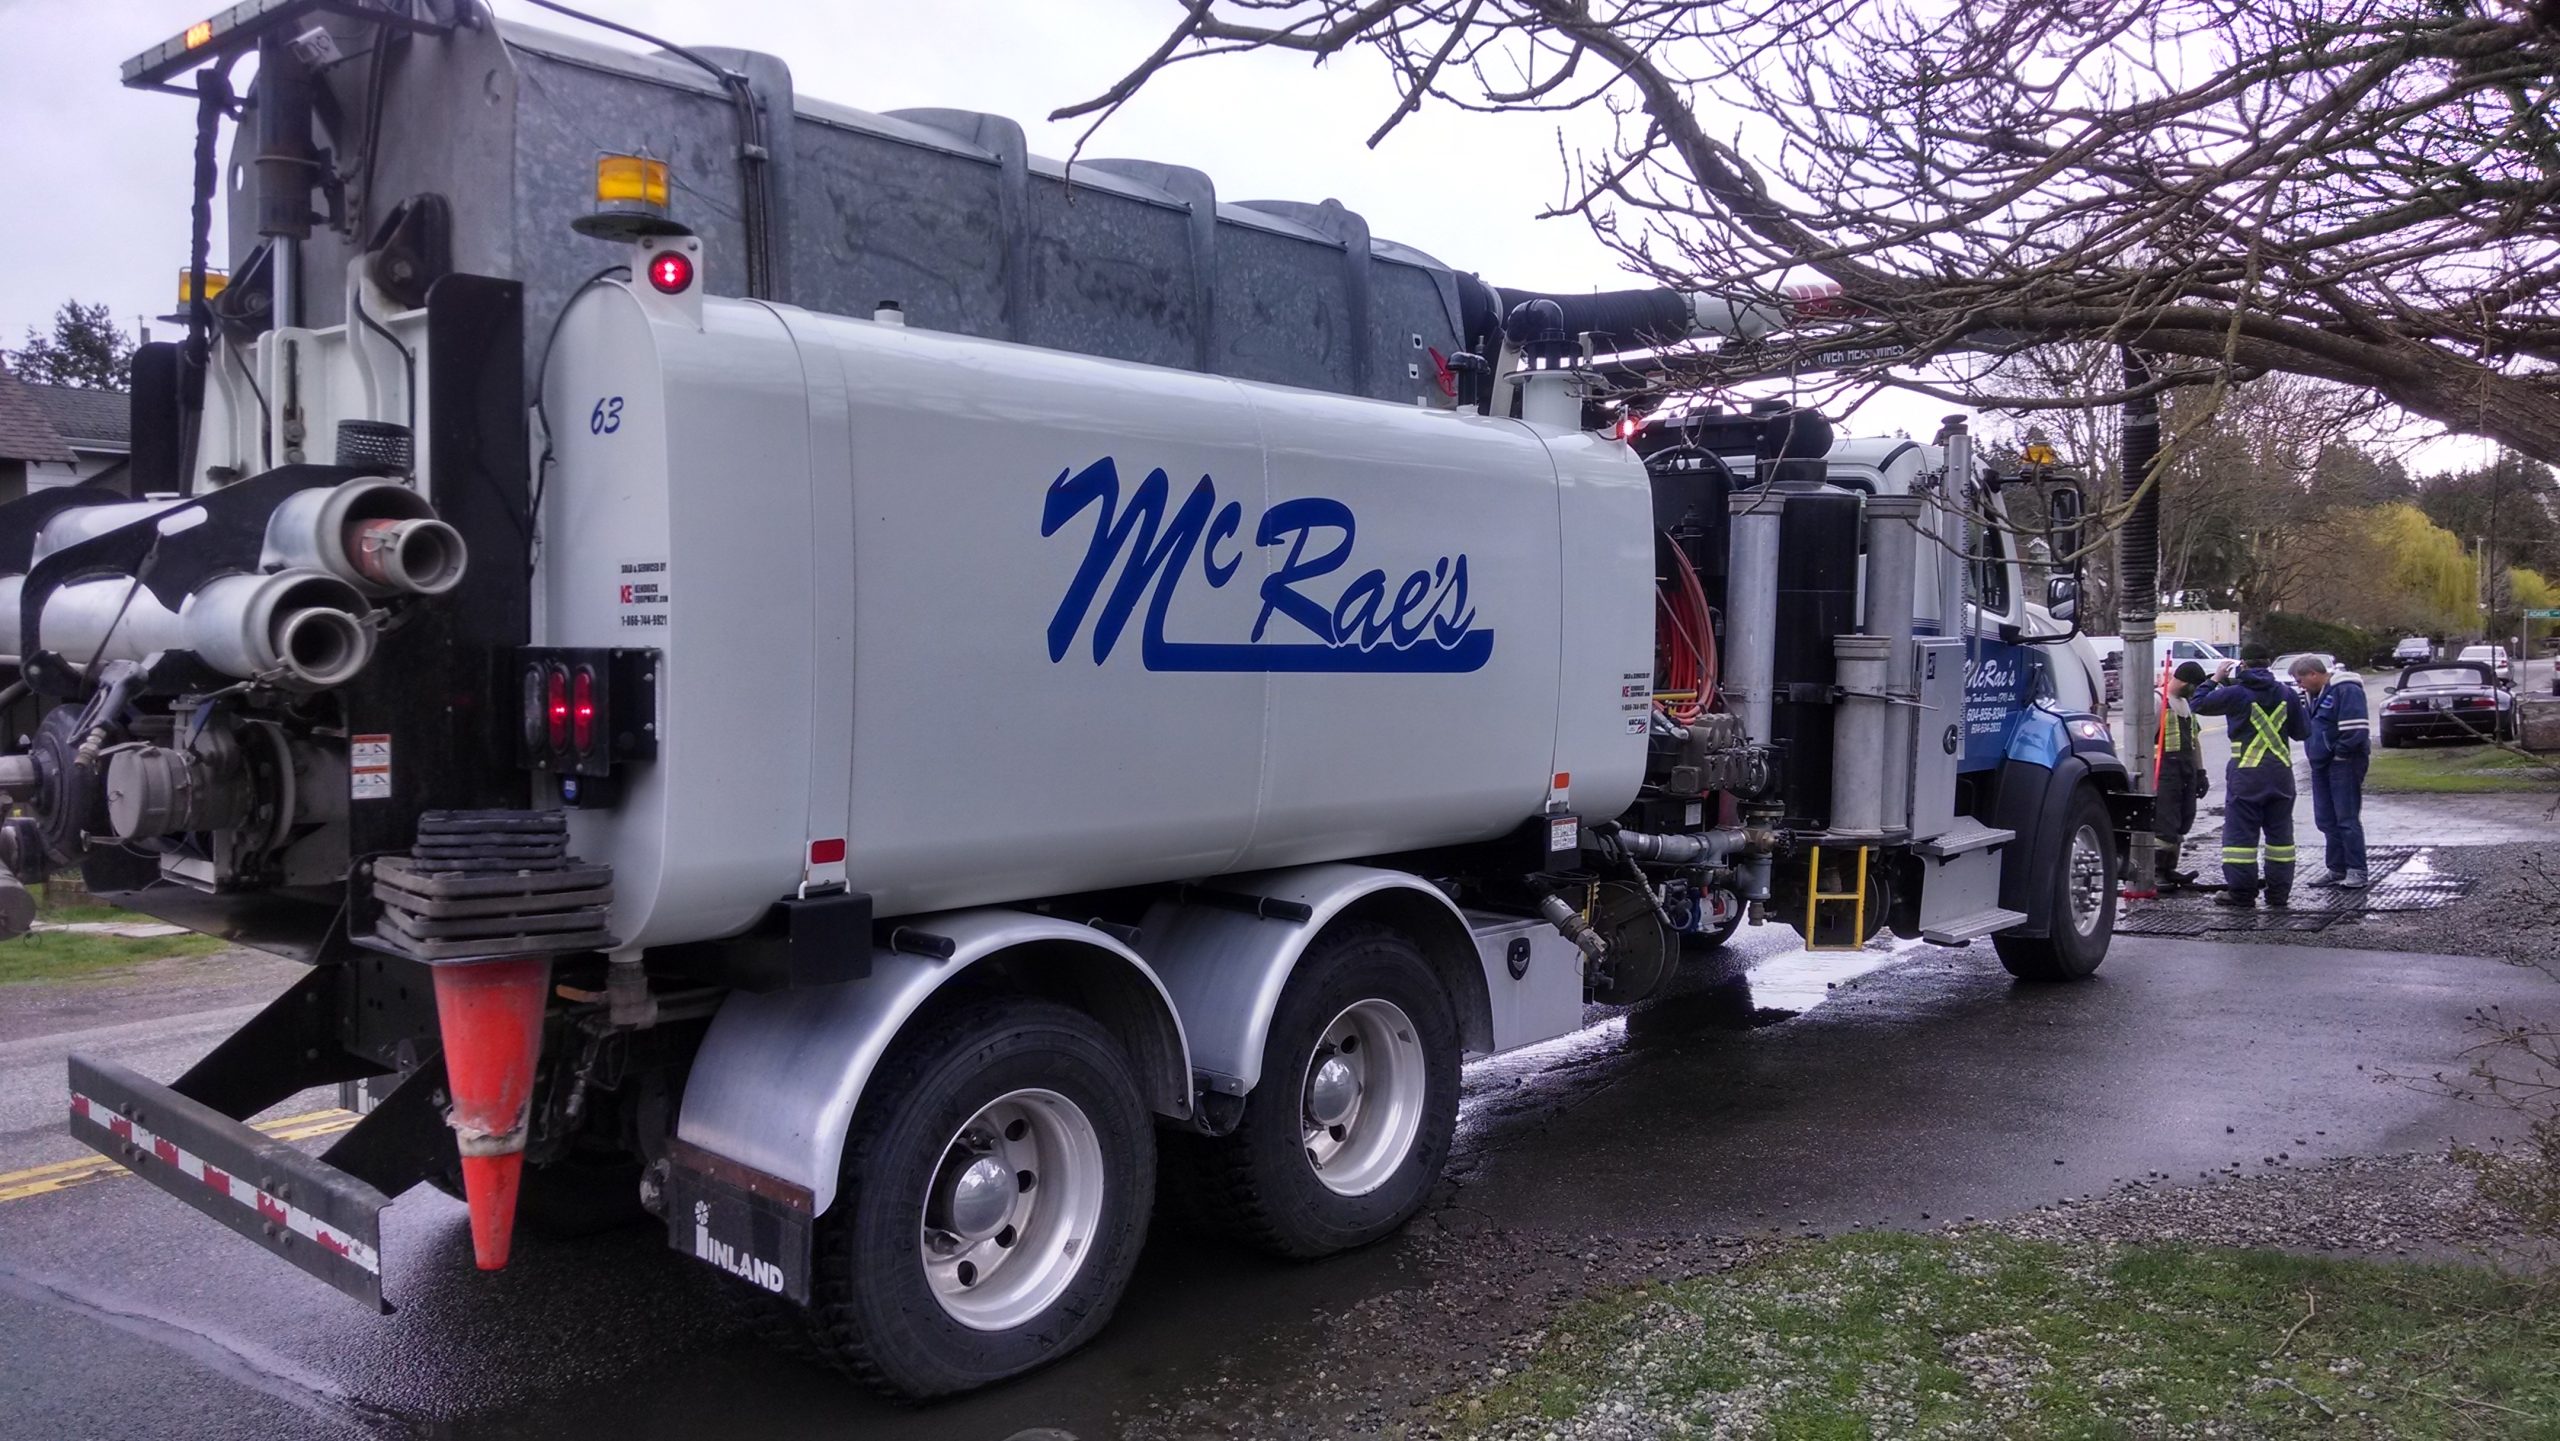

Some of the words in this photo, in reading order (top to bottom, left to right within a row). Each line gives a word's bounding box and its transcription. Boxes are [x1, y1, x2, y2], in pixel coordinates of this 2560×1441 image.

[591, 396, 624, 435] 63
[620, 585, 632, 604] KE
[708, 1237, 784, 1293] INLAND
